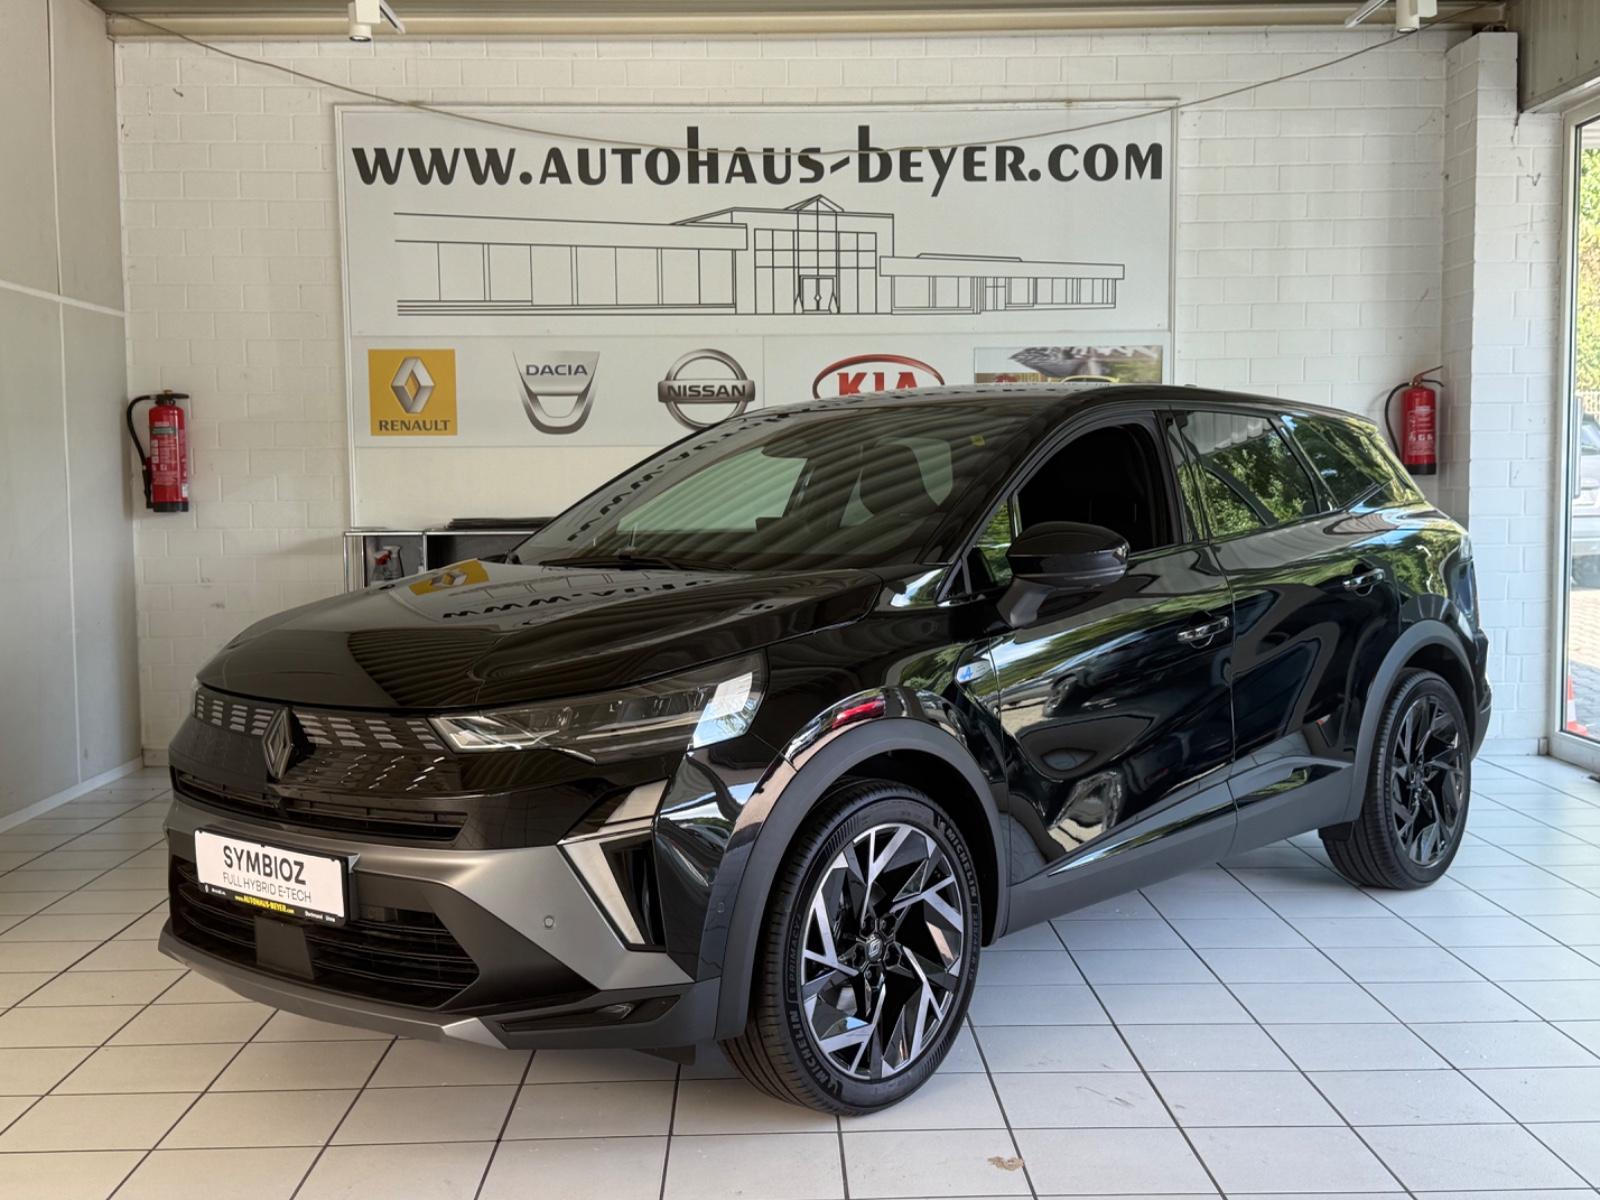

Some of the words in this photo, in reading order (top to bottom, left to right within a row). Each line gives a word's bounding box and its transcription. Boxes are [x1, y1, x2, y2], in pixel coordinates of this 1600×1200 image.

[525, 364, 588, 376] DACIA
[667, 384, 746, 398] NISSAN
[378, 419, 450, 432] RENAULT
[223, 845, 306, 884] SYMBIOZ
[945, 827, 977, 897] MICHELIN
[223, 872, 243, 887] FULL
[243, 880, 277, 896] HYBRID
[278, 886, 312, 903] E-TECH
[789, 1010, 832, 1088] MICHELIN
